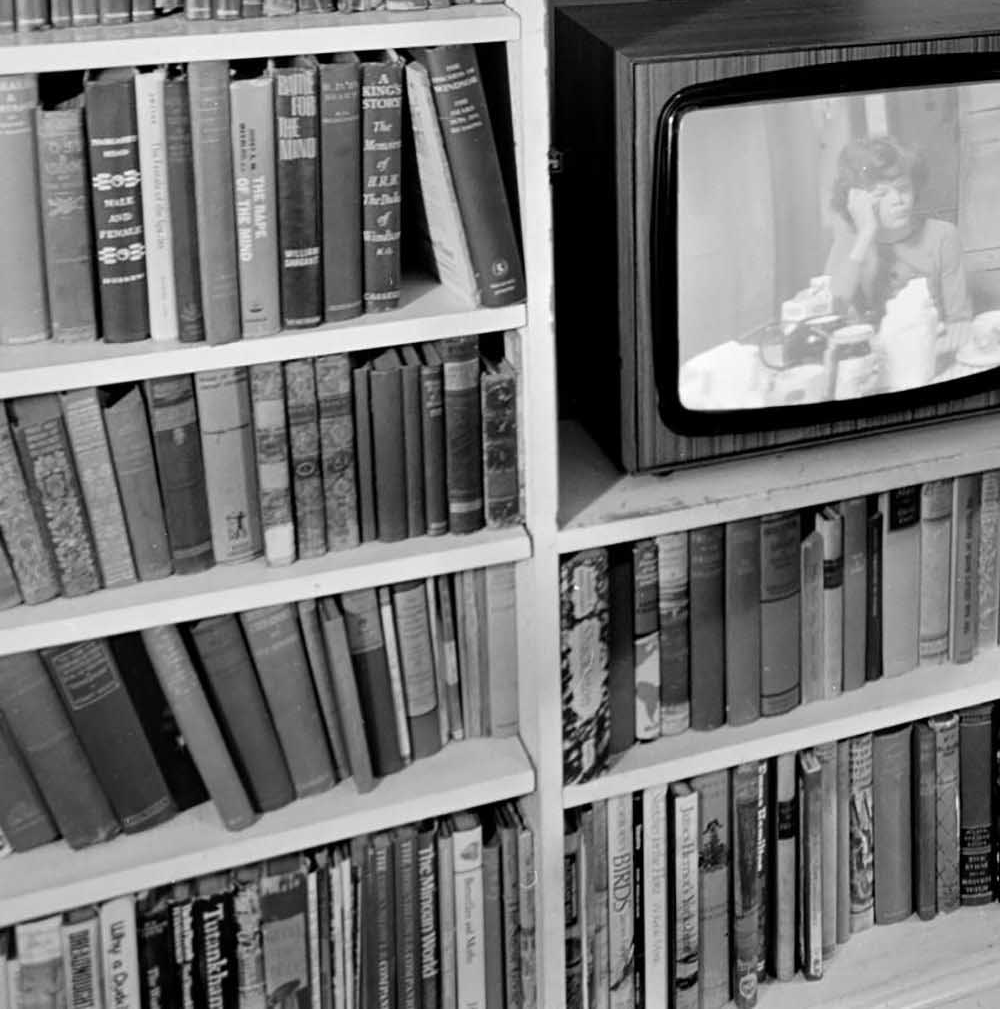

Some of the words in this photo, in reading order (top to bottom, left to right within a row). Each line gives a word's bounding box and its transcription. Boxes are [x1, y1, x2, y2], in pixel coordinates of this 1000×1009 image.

[377, 73, 389, 85] A
[362, 84, 401, 97] KING'S
[291, 95, 316, 116] FOR
[362, 98, 401, 109] STORY
[279, 117, 300, 138] THE
[373, 121, 392, 132] The
[280, 137, 316, 160] MIND
[376, 157, 391, 172] of
[237, 178, 250, 194] OF
[252, 176, 266, 202] THE
[104, 196, 134, 208] MALE
[109, 212, 133, 223] AND
[238, 201, 251, 225] THE
[254, 205, 267, 239] RAPE
[377, 211, 392, 227] of
[100, 225, 143, 239] FEMALE
[239, 229, 253, 262] MIND
[757, 807, 767, 872] Hamilton
[418, 845, 435, 874] The
[612, 852, 633, 913] BIRDS
[419, 874, 436, 933] Minoan
[108, 920, 126, 954] Why
[111, 958, 123, 970] a
[422, 932, 439, 979] World
